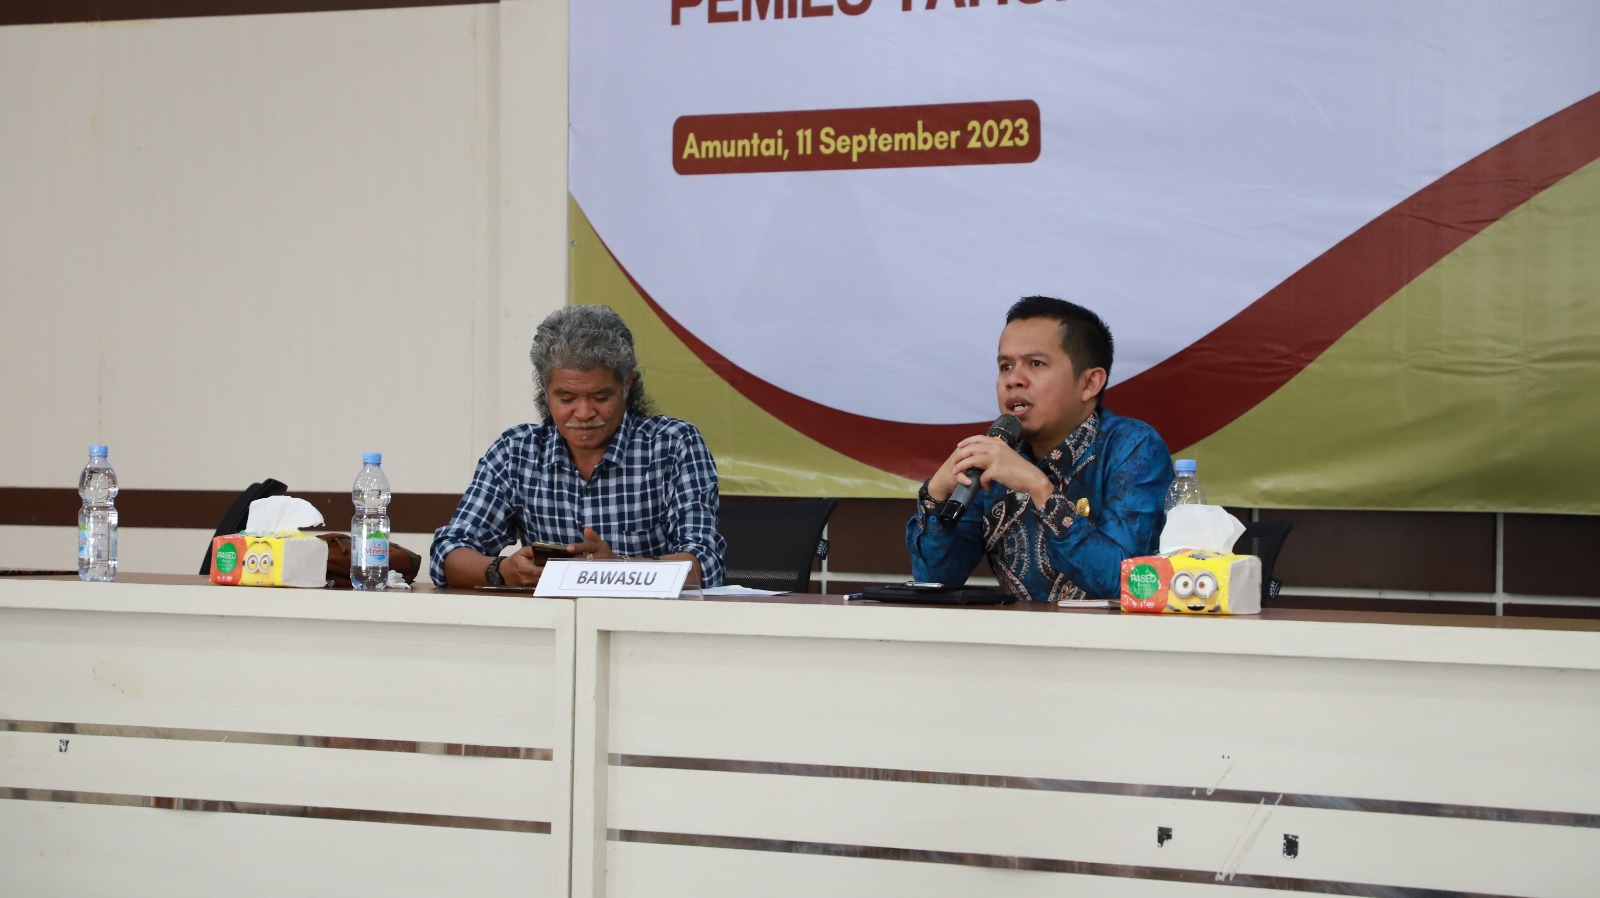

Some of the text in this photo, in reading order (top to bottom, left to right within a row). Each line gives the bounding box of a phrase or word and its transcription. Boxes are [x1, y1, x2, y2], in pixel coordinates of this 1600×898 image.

[682, 118, 1030, 162] Amuntai, 11 September 2023
[576, 570, 658, 586] BAWASLU
[1130, 574, 1157, 583] PASEO
